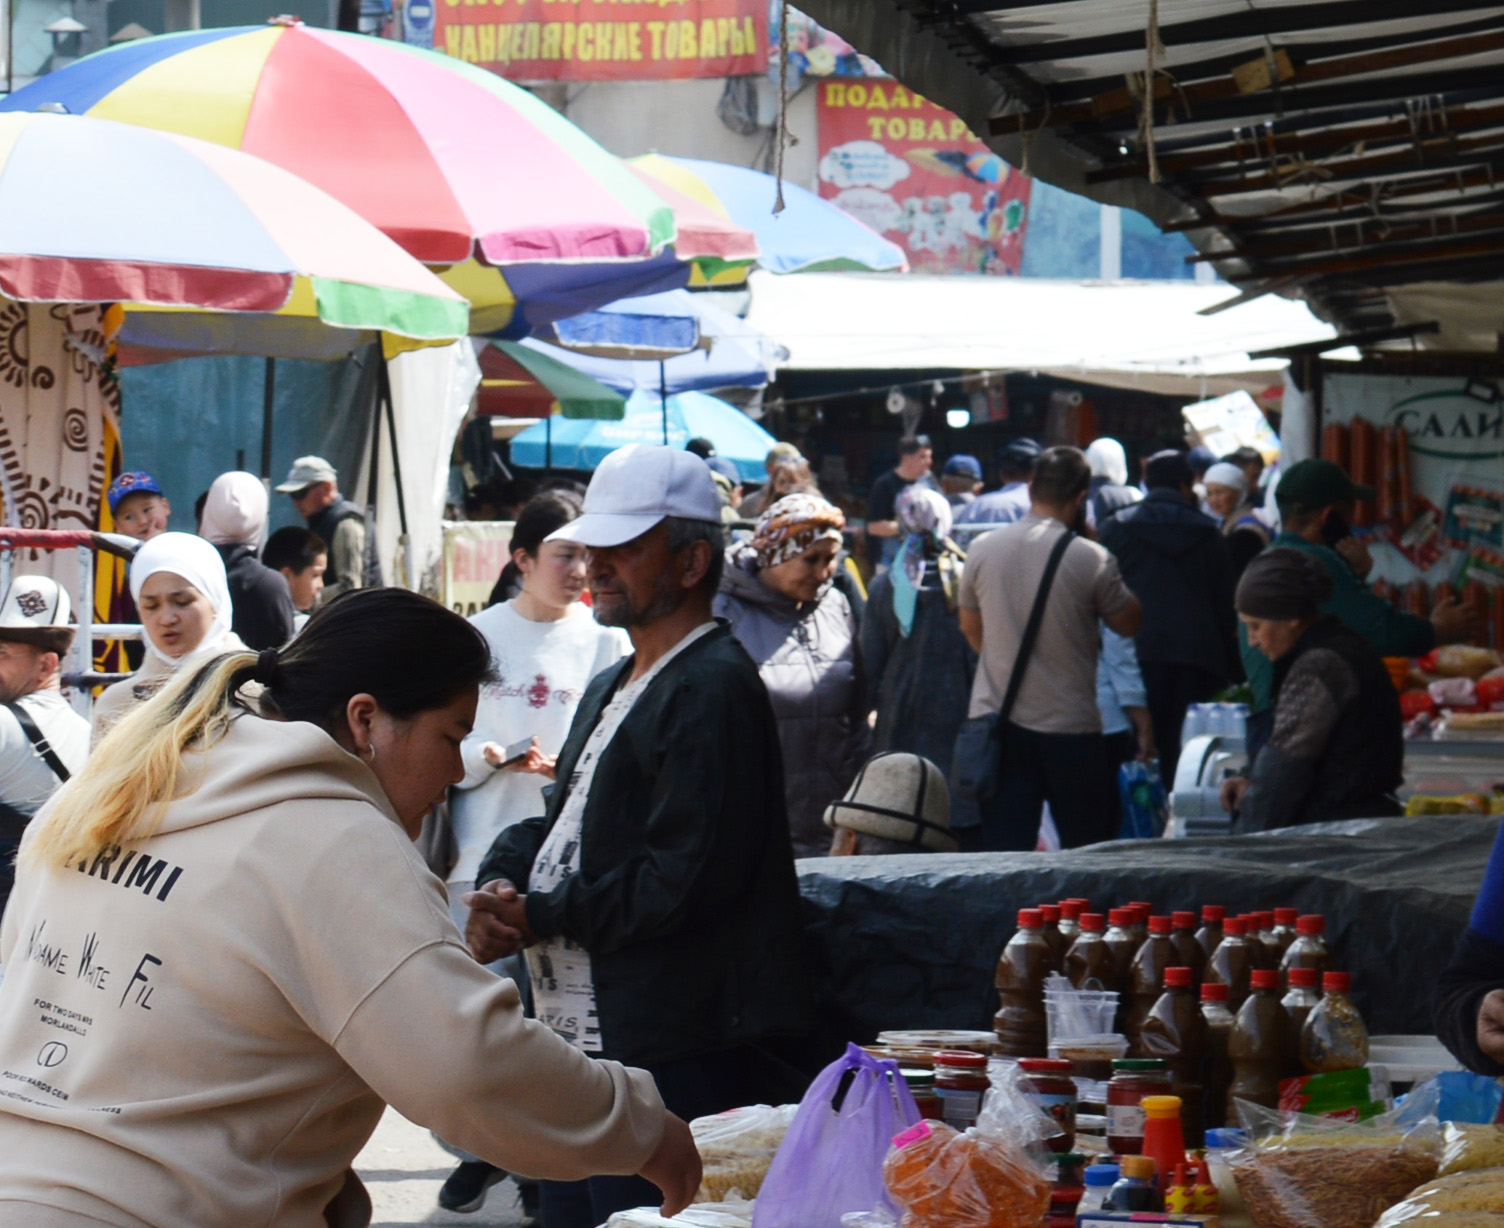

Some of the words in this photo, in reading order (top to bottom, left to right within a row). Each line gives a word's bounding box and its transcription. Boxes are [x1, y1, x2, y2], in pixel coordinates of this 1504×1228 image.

[445, 21, 642, 65] КАНЦЕЛЯРСКИЕ
[646, 15, 757, 60] ТОВАРЫ
[34, 998, 52, 1012] FOR
[119, 953, 163, 1011] FIL
